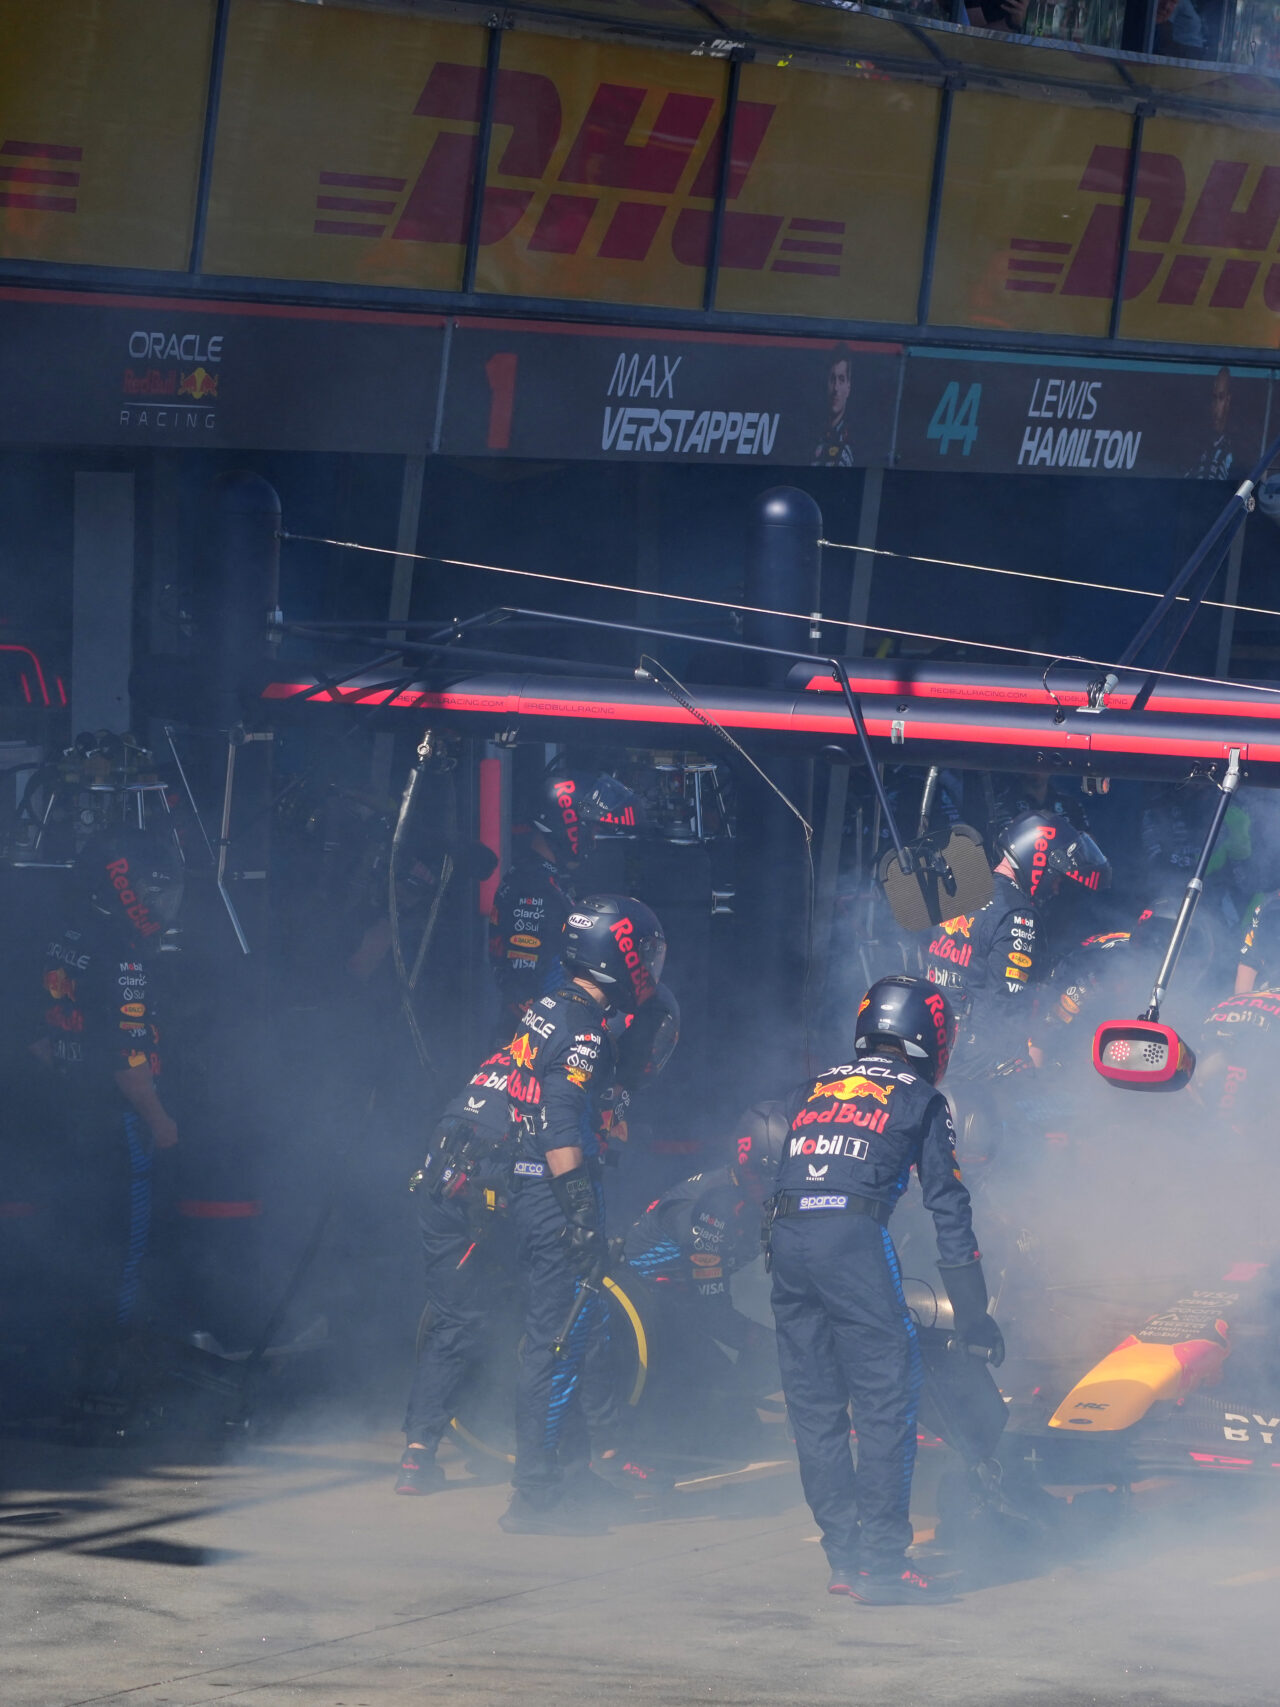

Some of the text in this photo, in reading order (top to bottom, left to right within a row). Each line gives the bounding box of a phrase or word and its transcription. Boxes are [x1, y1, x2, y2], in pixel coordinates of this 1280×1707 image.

[391, 61, 779, 271] DHL
[128, 331, 224, 362] ORACLE
[607, 353, 682, 398] MAX
[485, 353, 518, 449] 1
[1028, 378, 1102, 420] LEWIS
[120, 410, 216, 428] RACING
[926, 381, 982, 456] 44
[602, 406, 780, 455] VERSTAPPEN
[1017, 426, 1142, 470] HAMILTON
[519, 896, 543, 906] Mobil
[513, 908, 541, 920] Claro
[570, 915, 590, 928] HJC
[1013, 915, 1034, 928] Mobil
[525, 922, 539, 932] Sui
[1011, 928, 1034, 941] Claro
[120, 962, 143, 972] Mobil
[118, 975, 145, 987] Claro
[521, 1008, 555, 1039] RACLE
[575, 1033, 601, 1045] Mobil
[818, 1065, 917, 1085] ORACLE
[792, 1101, 890, 1135] Red Bull
[790, 1135, 844, 1158] Mobil
[514, 1162, 544, 1176] arco
[800, 1196, 847, 1208] sparco
[700, 1212, 725, 1230] Mobil
[692, 1226, 720, 1243] Claro
[699, 1281, 725, 1295] VISA
